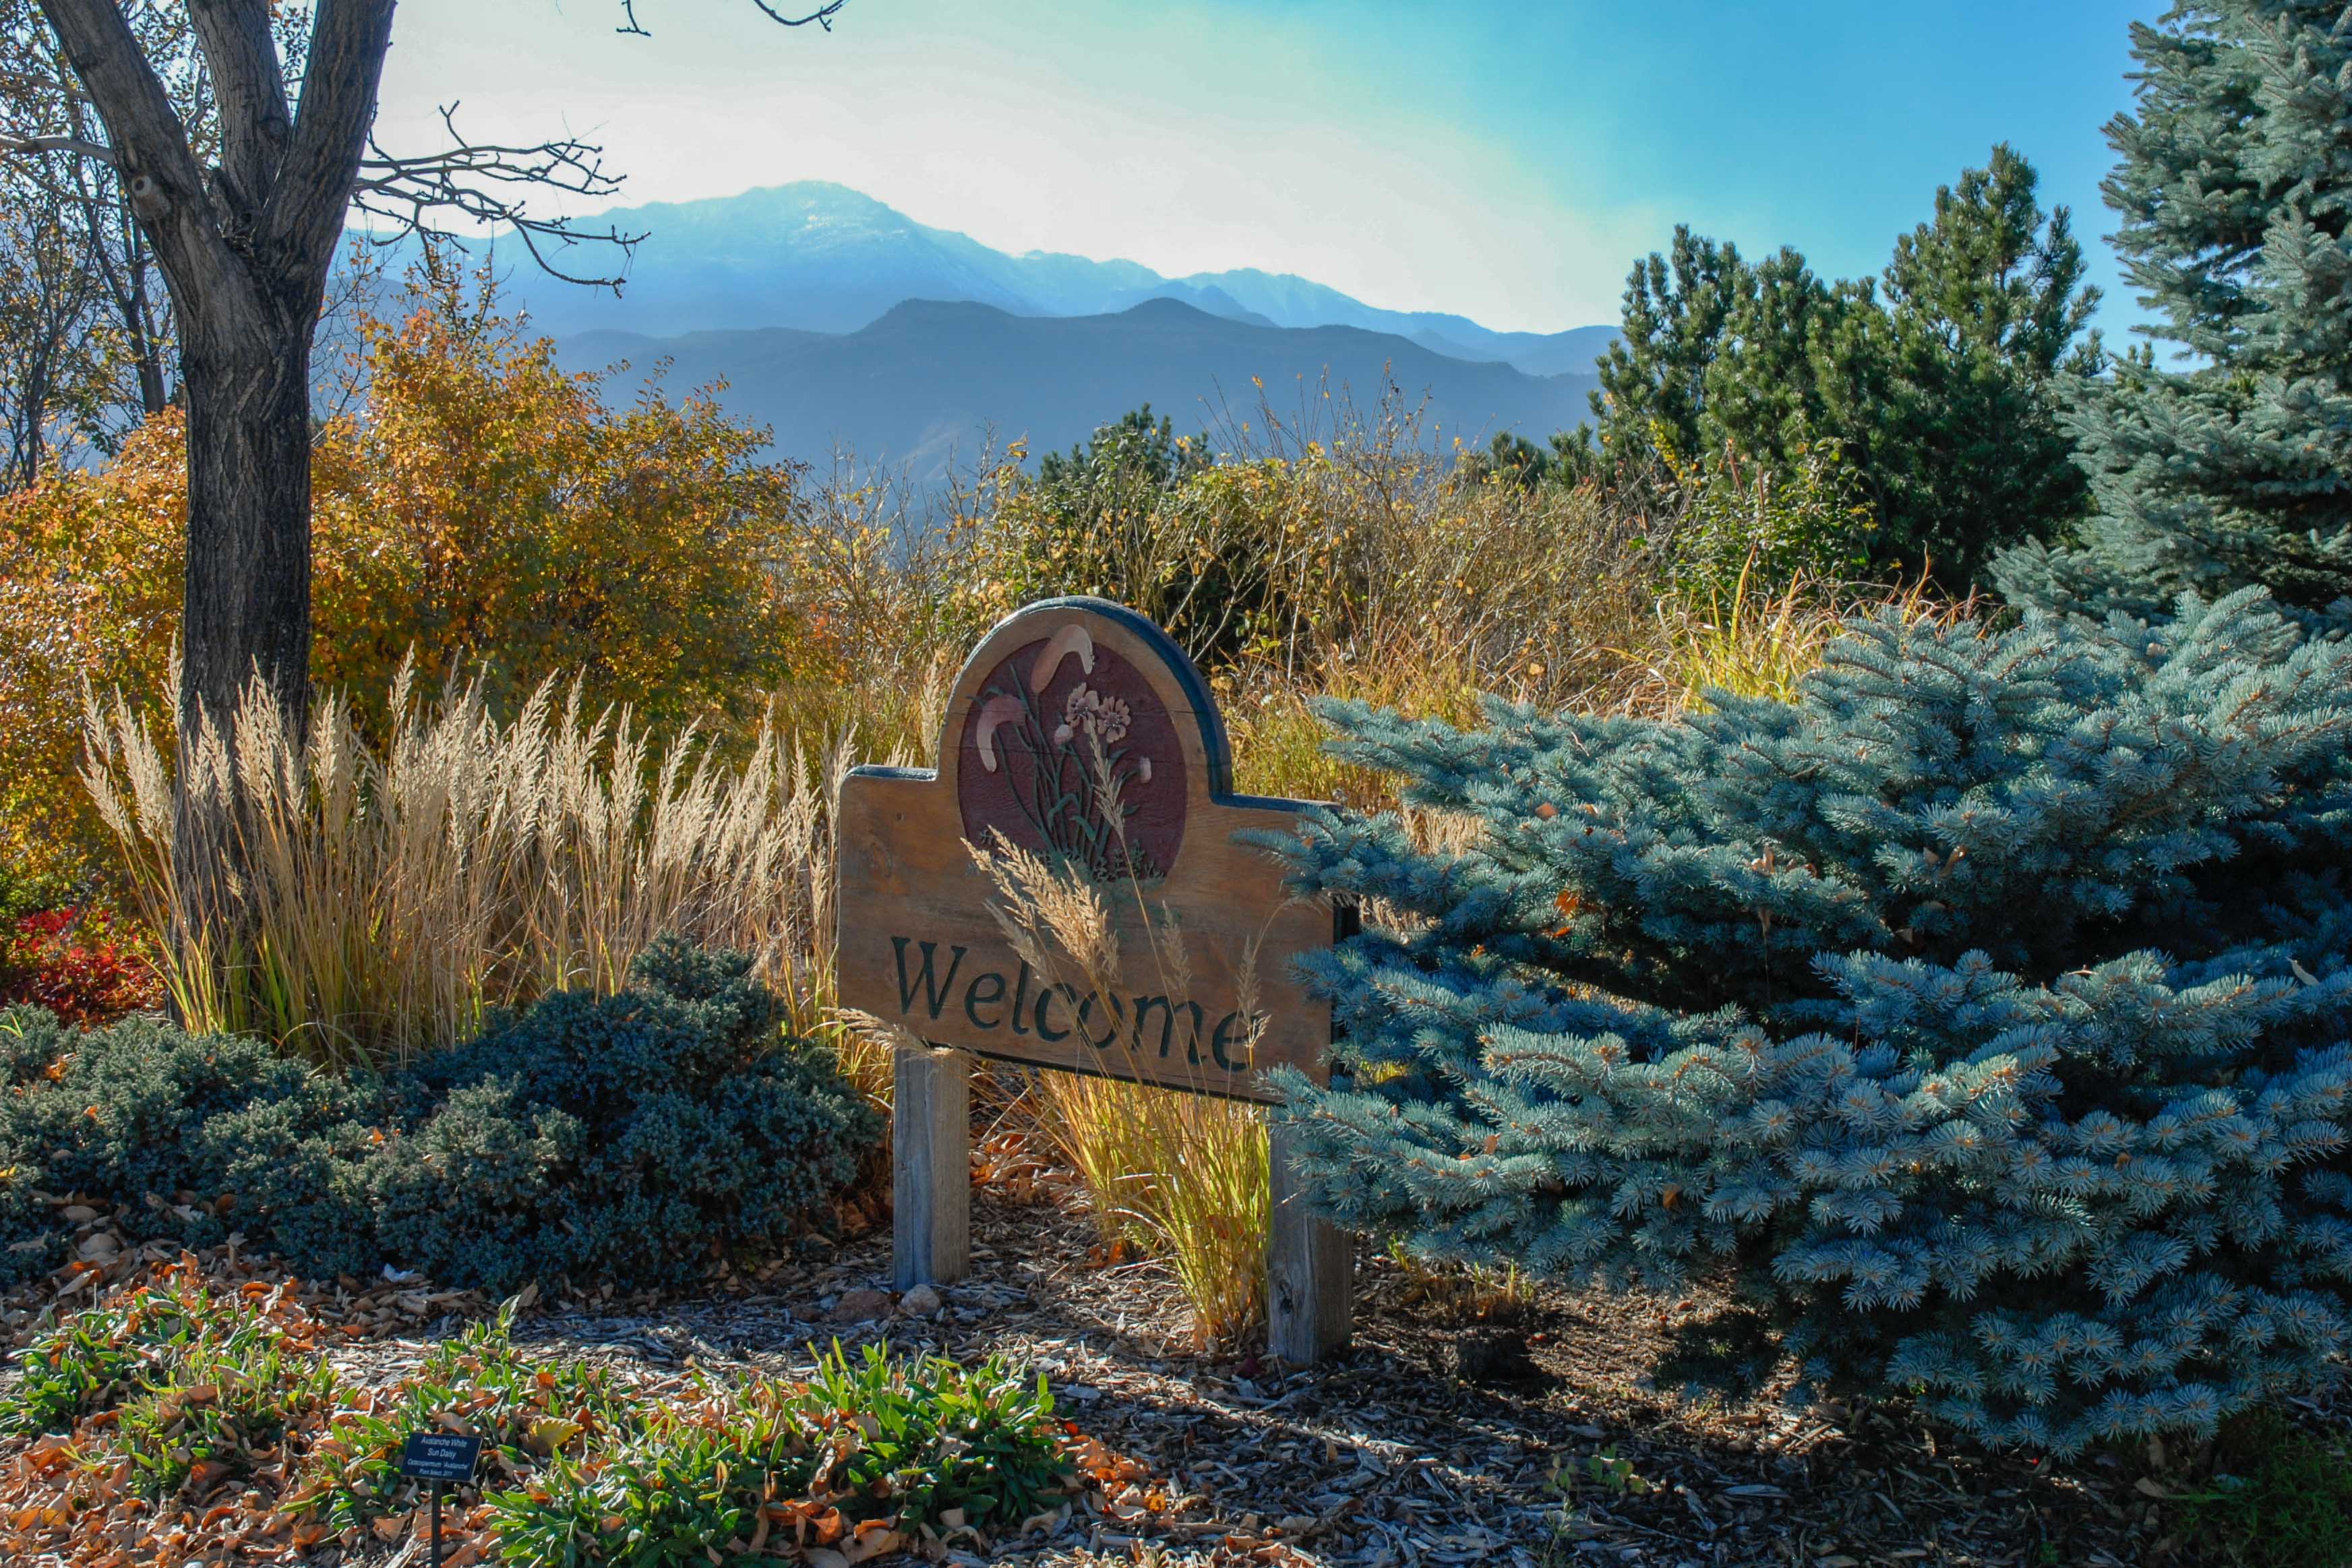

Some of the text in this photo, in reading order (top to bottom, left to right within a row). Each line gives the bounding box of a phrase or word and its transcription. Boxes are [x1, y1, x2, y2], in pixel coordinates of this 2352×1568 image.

[891, 936, 1261, 1072] Welcome
[421, 1436, 467, 1447] Avalanche White
[427, 1448, 457, 1459] Sun Daisy
